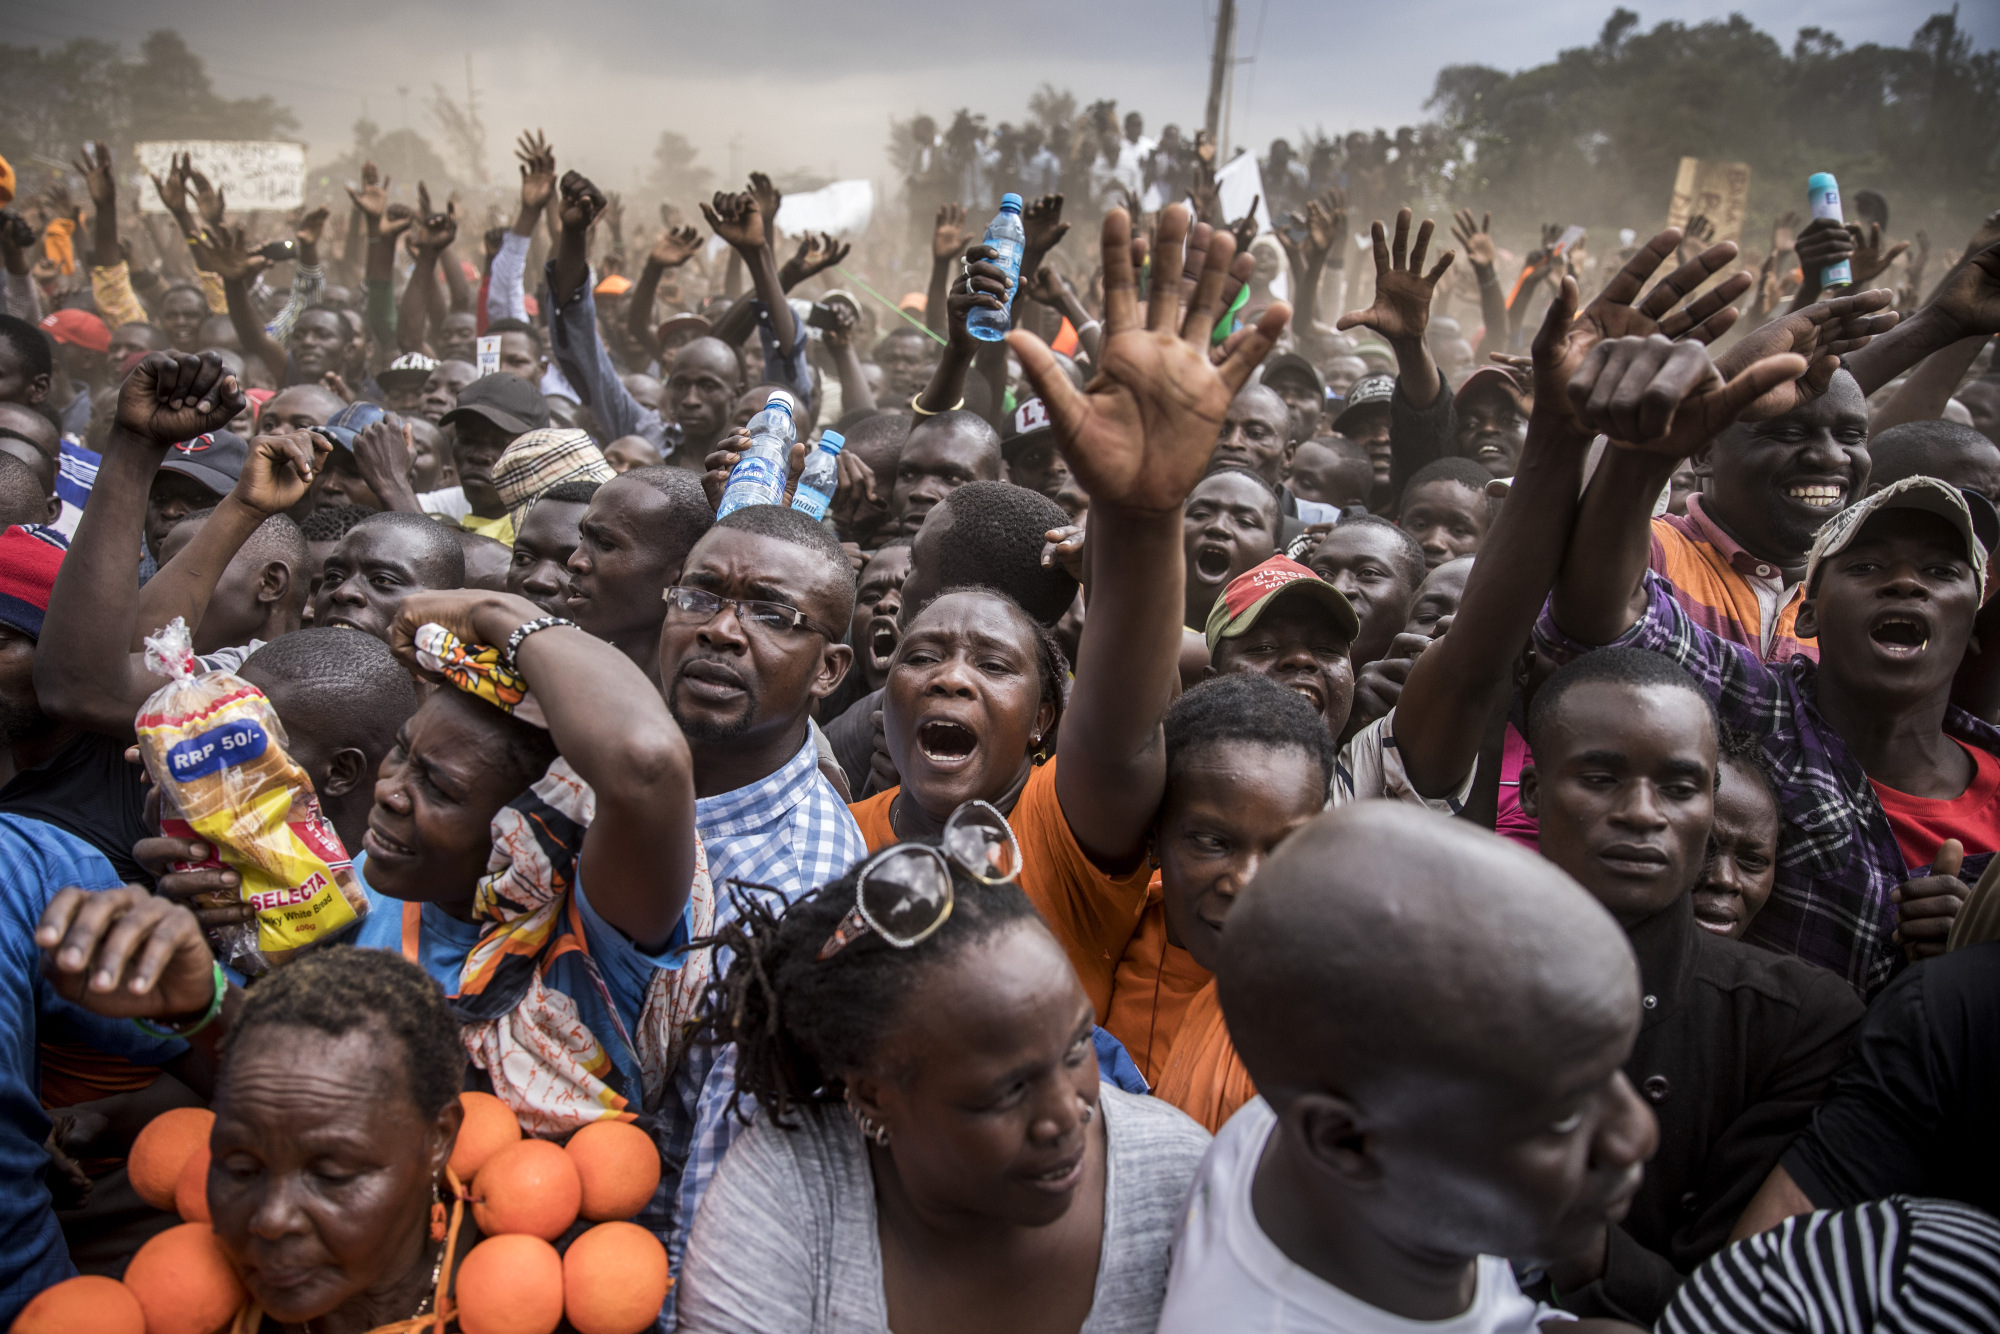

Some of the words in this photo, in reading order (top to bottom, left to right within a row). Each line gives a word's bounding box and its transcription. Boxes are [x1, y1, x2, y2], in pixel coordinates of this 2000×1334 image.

[173, 743, 214, 770] RRP
[222, 728, 261, 753] 50/-
[306, 797, 338, 851] SELECTA
[249, 871, 327, 911] SELECTA
[284, 909, 312, 921] White
[313, 893, 332, 914] Bread
[295, 924, 316, 932] 400g
